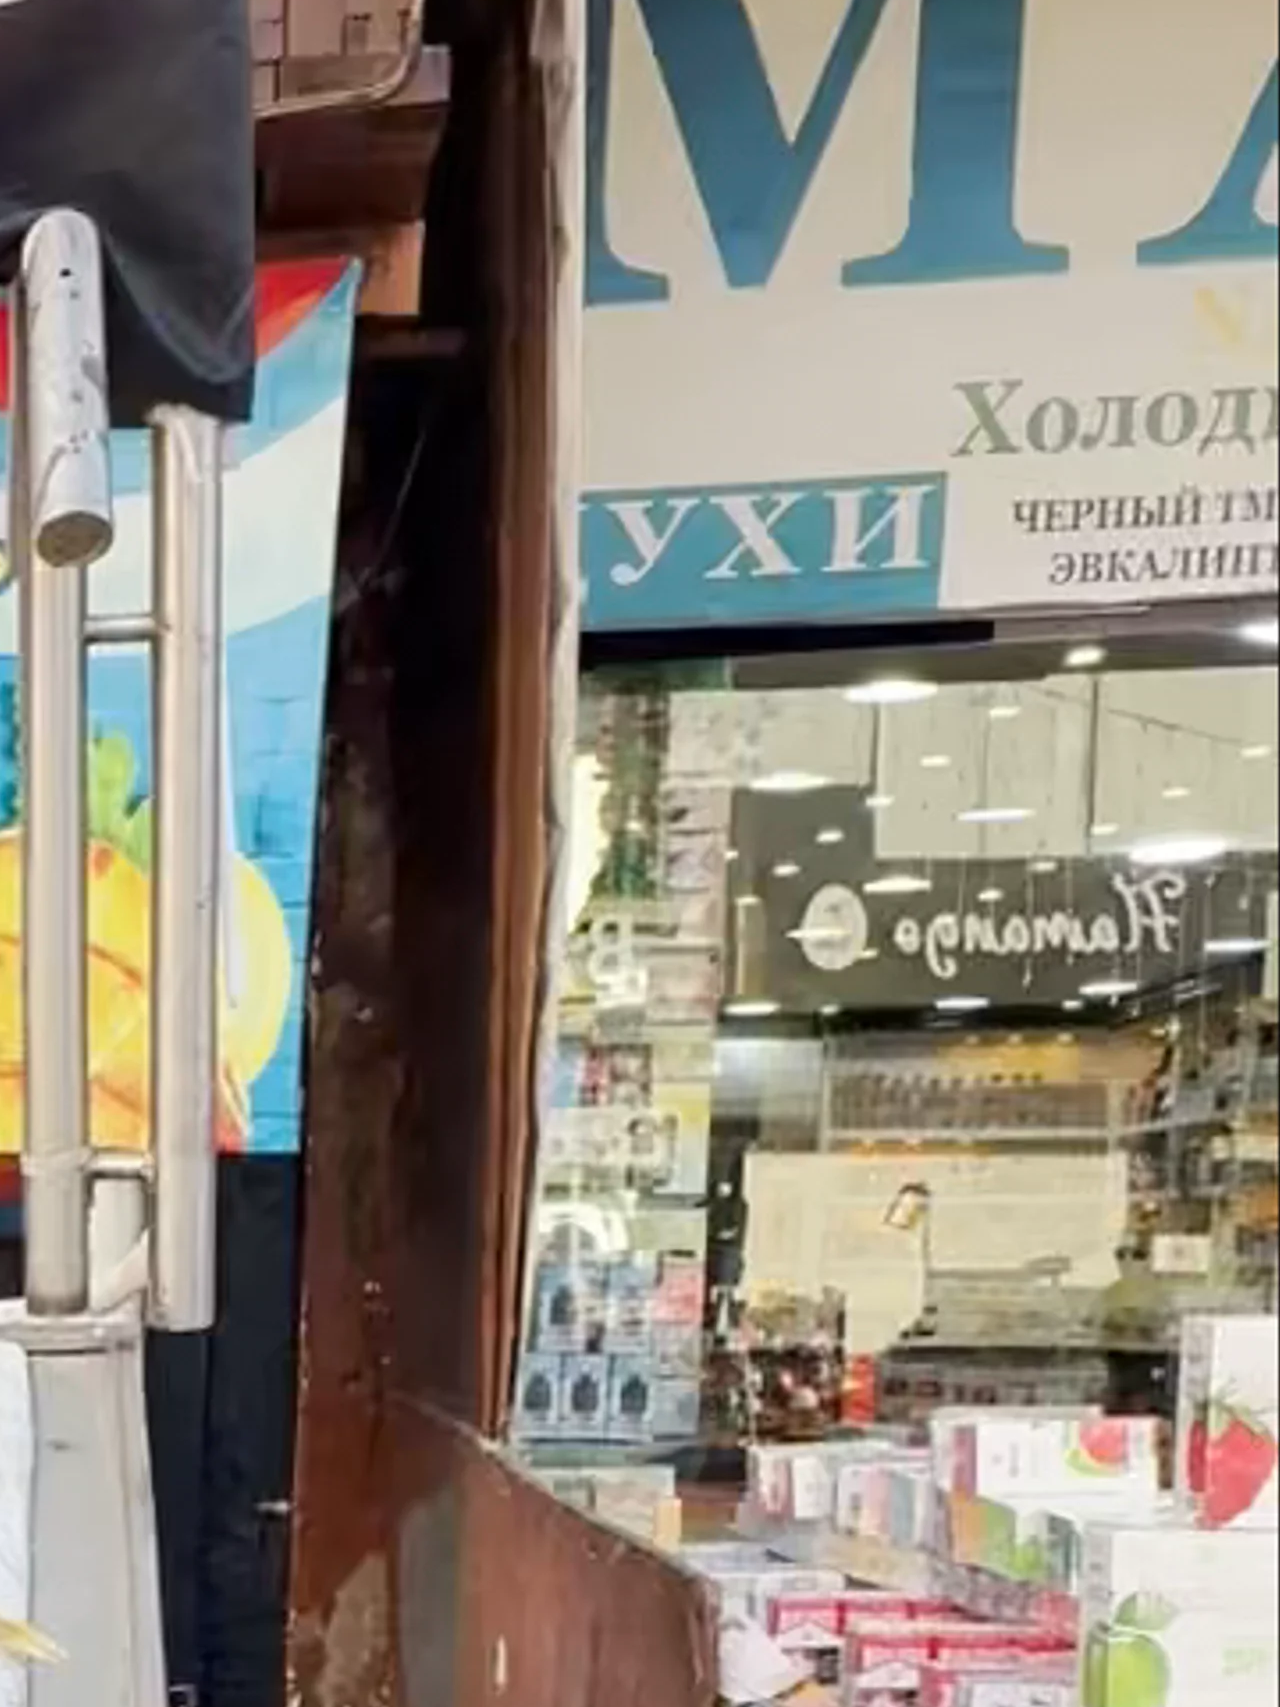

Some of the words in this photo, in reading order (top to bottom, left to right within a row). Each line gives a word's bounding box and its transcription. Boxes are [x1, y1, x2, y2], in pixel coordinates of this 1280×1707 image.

[950, 378, 1278, 457] Холод
[580, 485, 938, 586] УХИ
[1013, 485, 1202, 533] ЧЕРНЫЙ
